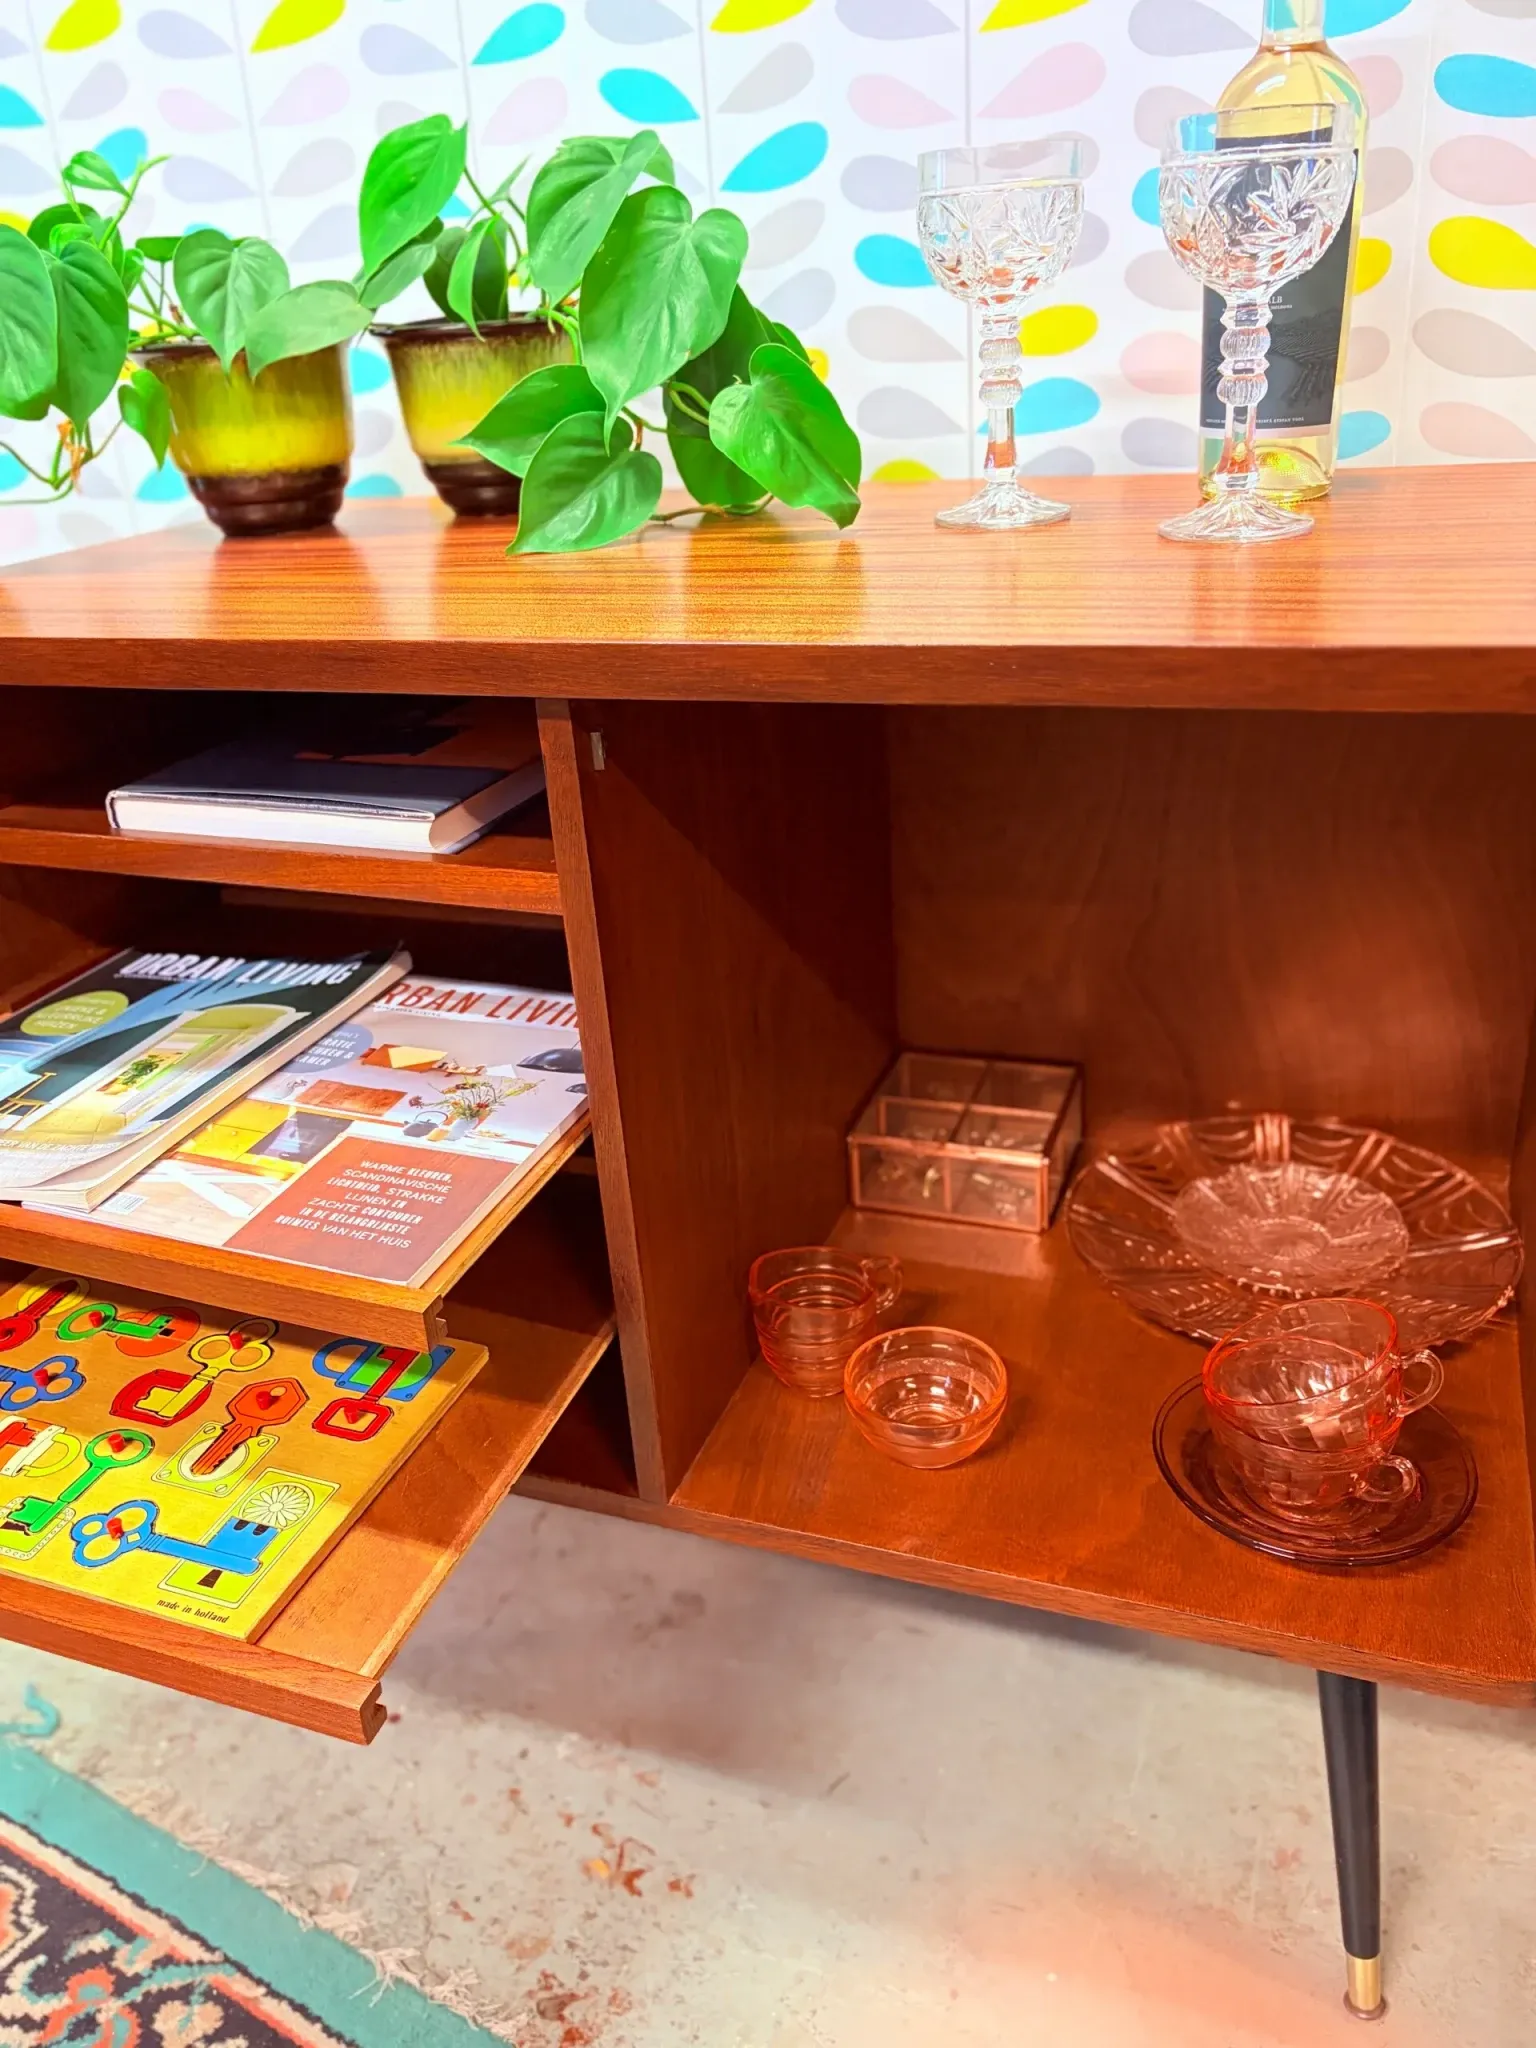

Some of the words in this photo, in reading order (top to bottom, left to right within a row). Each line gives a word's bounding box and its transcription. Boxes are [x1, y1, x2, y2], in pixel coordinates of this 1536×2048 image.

[120, 952, 245, 981] URBAN
[235, 960, 362, 986] LIVING
[384, 982, 487, 1014] RBAN
[360, 1160, 405, 1174] WARME
[343, 1168, 452, 1194] SCANDINAVISCHE
[345, 1192, 392, 1207] LIJNEN
[391, 1199, 408, 1209] EN
[386, 1187, 447, 1205] STRAKKE
[299, 1207, 312, 1216] IN
[312, 1209, 327, 1219] DE
[328, 1212, 411, 1235] BELANGRIJKSTE
[308, 1197, 359, 1213] ZACHTE
[361, 1205, 423, 1224] CONTOUREN
[274, 1214, 321, 1231] RUIMTES
[321, 1223, 349, 1236] VAN
[349, 1229, 378, 1241] HET
[378, 1234, 412, 1249] HUIS
[157, 1599, 180, 1610] made
[182, 1604, 193, 1613] in
[194, 1608, 230, 1623] holland
